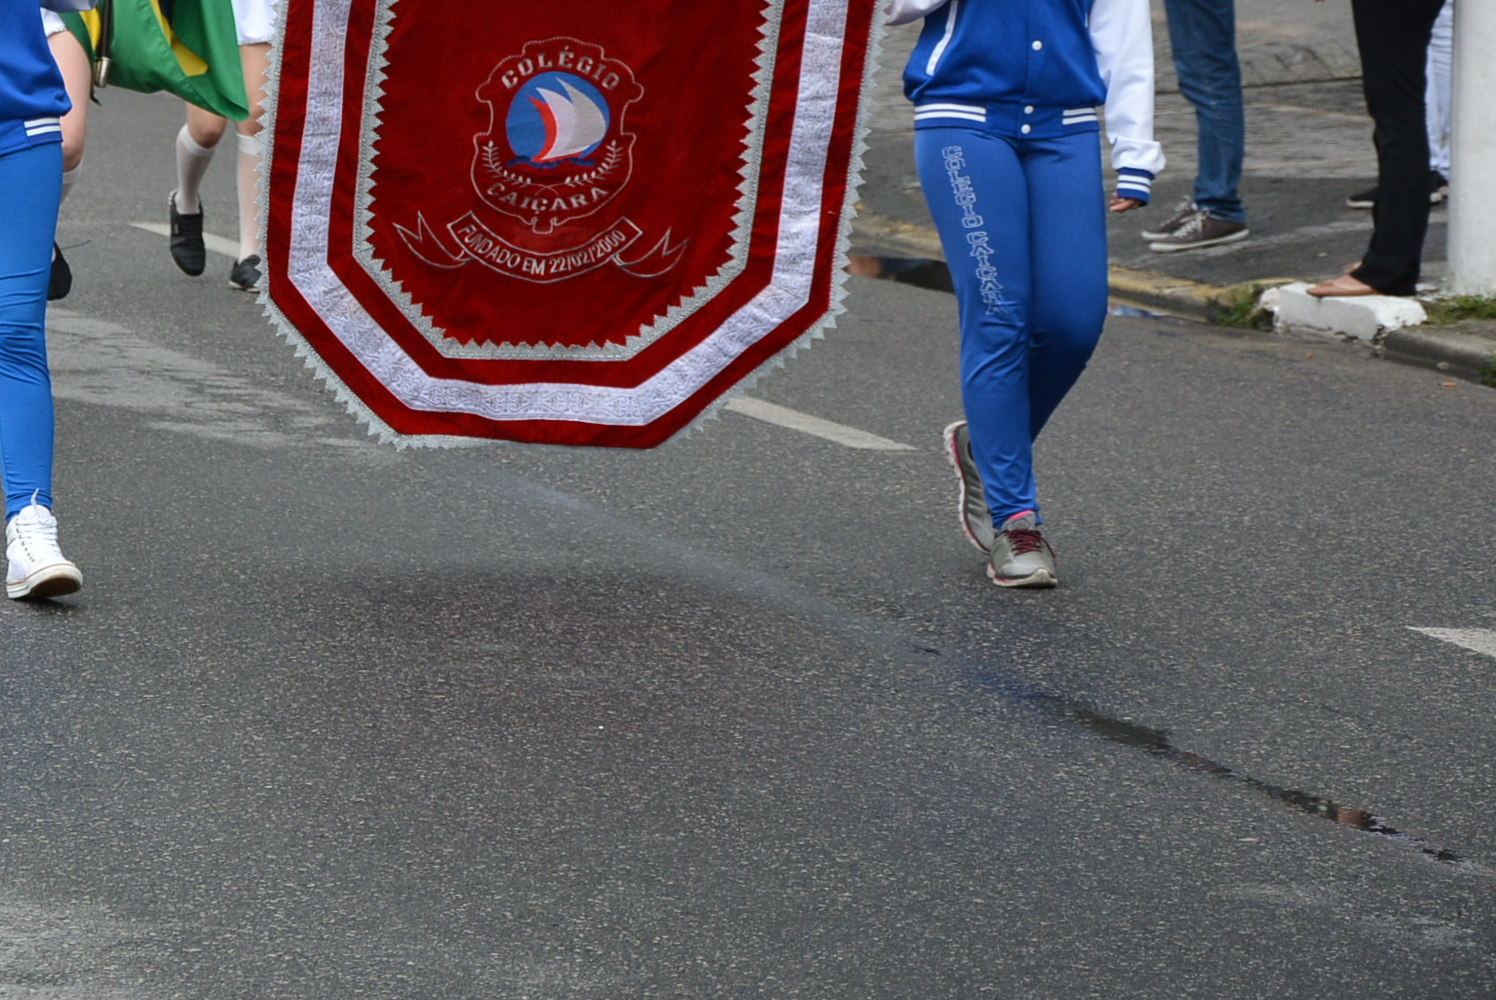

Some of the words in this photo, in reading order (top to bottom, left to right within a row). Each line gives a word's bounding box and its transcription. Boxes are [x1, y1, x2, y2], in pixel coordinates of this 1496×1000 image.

[501, 45, 620, 90] COLÉGIO
[487, 182, 609, 214] CAIÇARA
[457, 224, 521, 269] FUNDADO
[522, 255, 545, 276] EM
[549, 229, 627, 274] 22/02/2000
